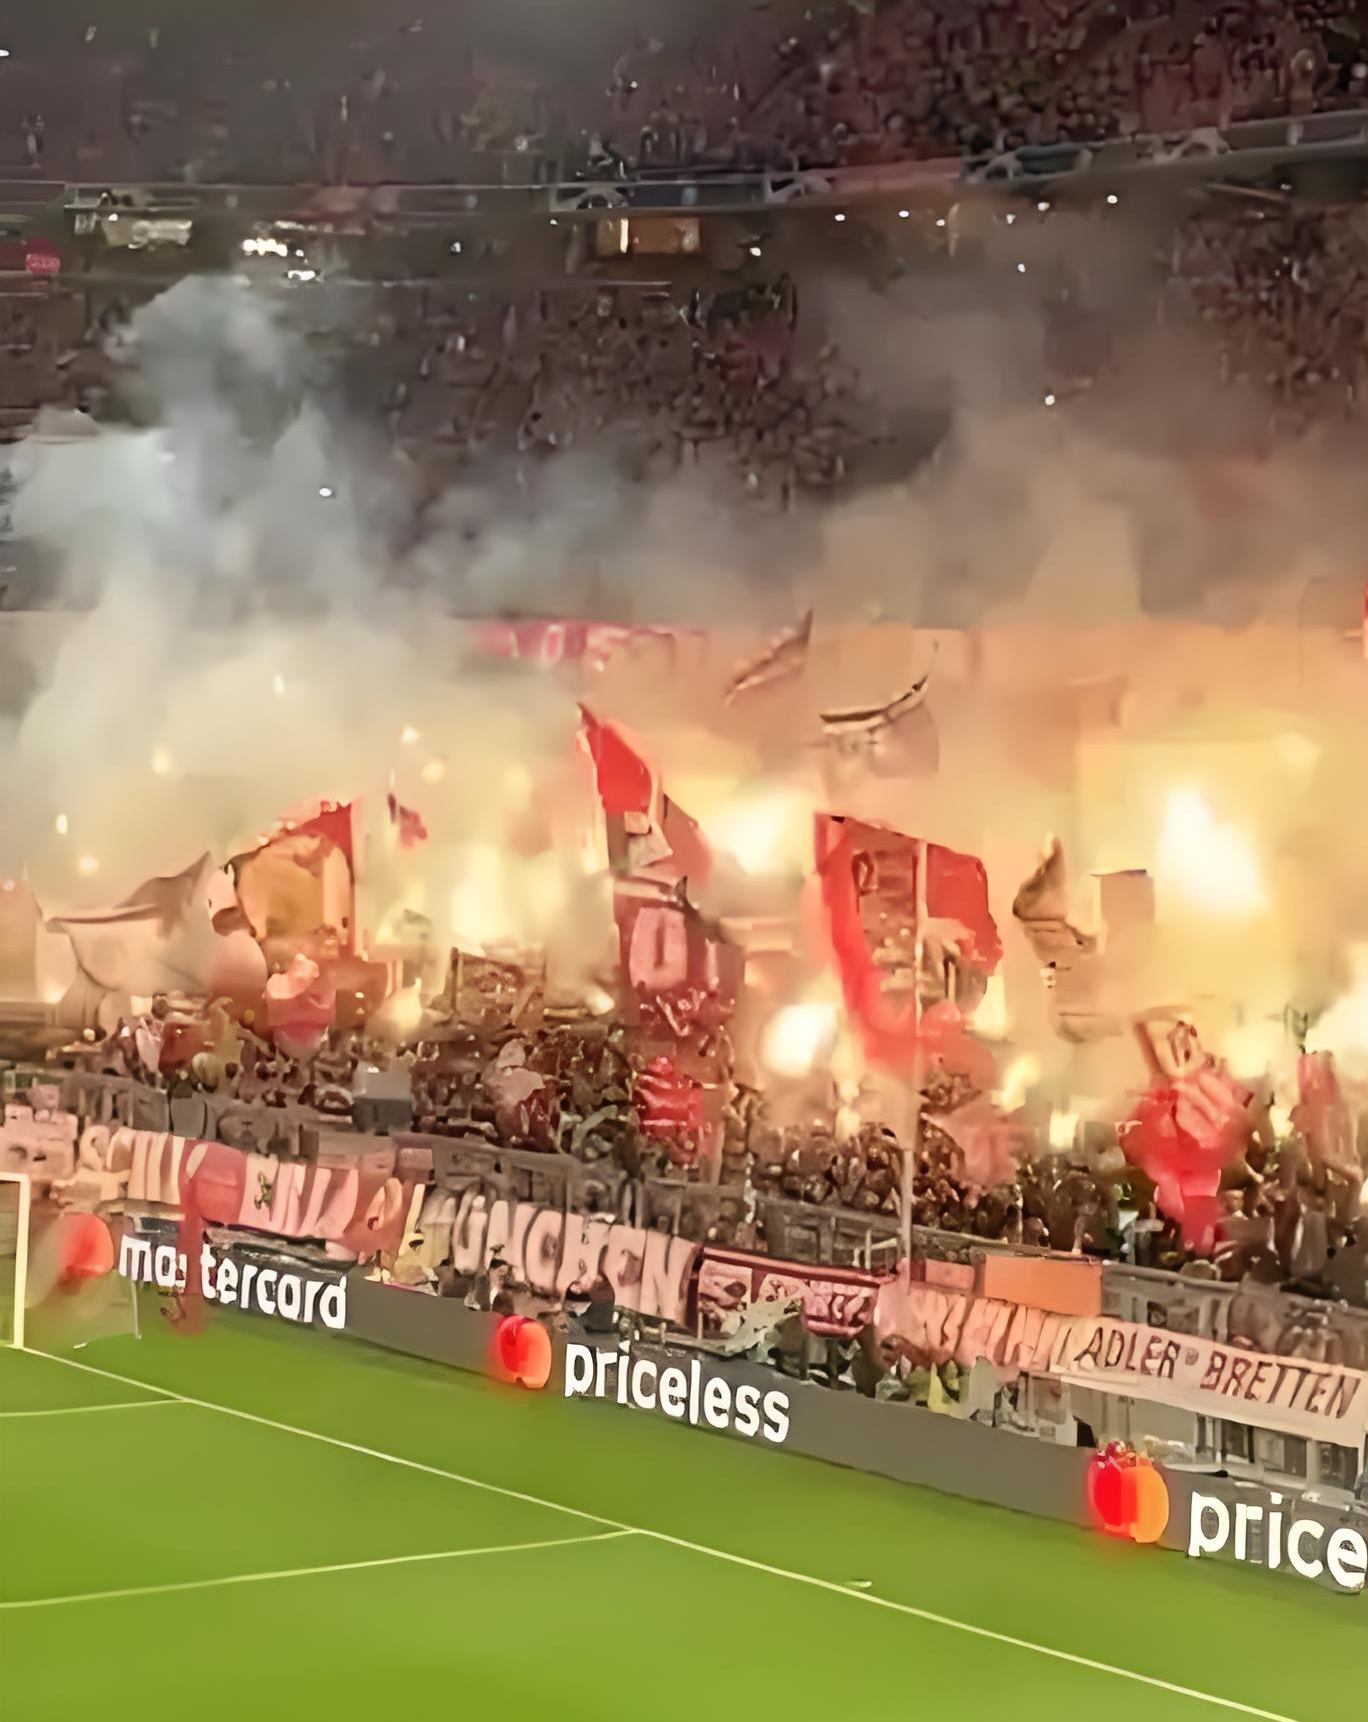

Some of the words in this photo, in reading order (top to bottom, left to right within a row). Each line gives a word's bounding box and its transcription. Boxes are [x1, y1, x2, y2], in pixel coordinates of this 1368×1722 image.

[564, 1339, 790, 1443] priceless
[1073, 1326, 1181, 1379] ADLER
[1200, 1350, 1362, 1419] BRETTEN
